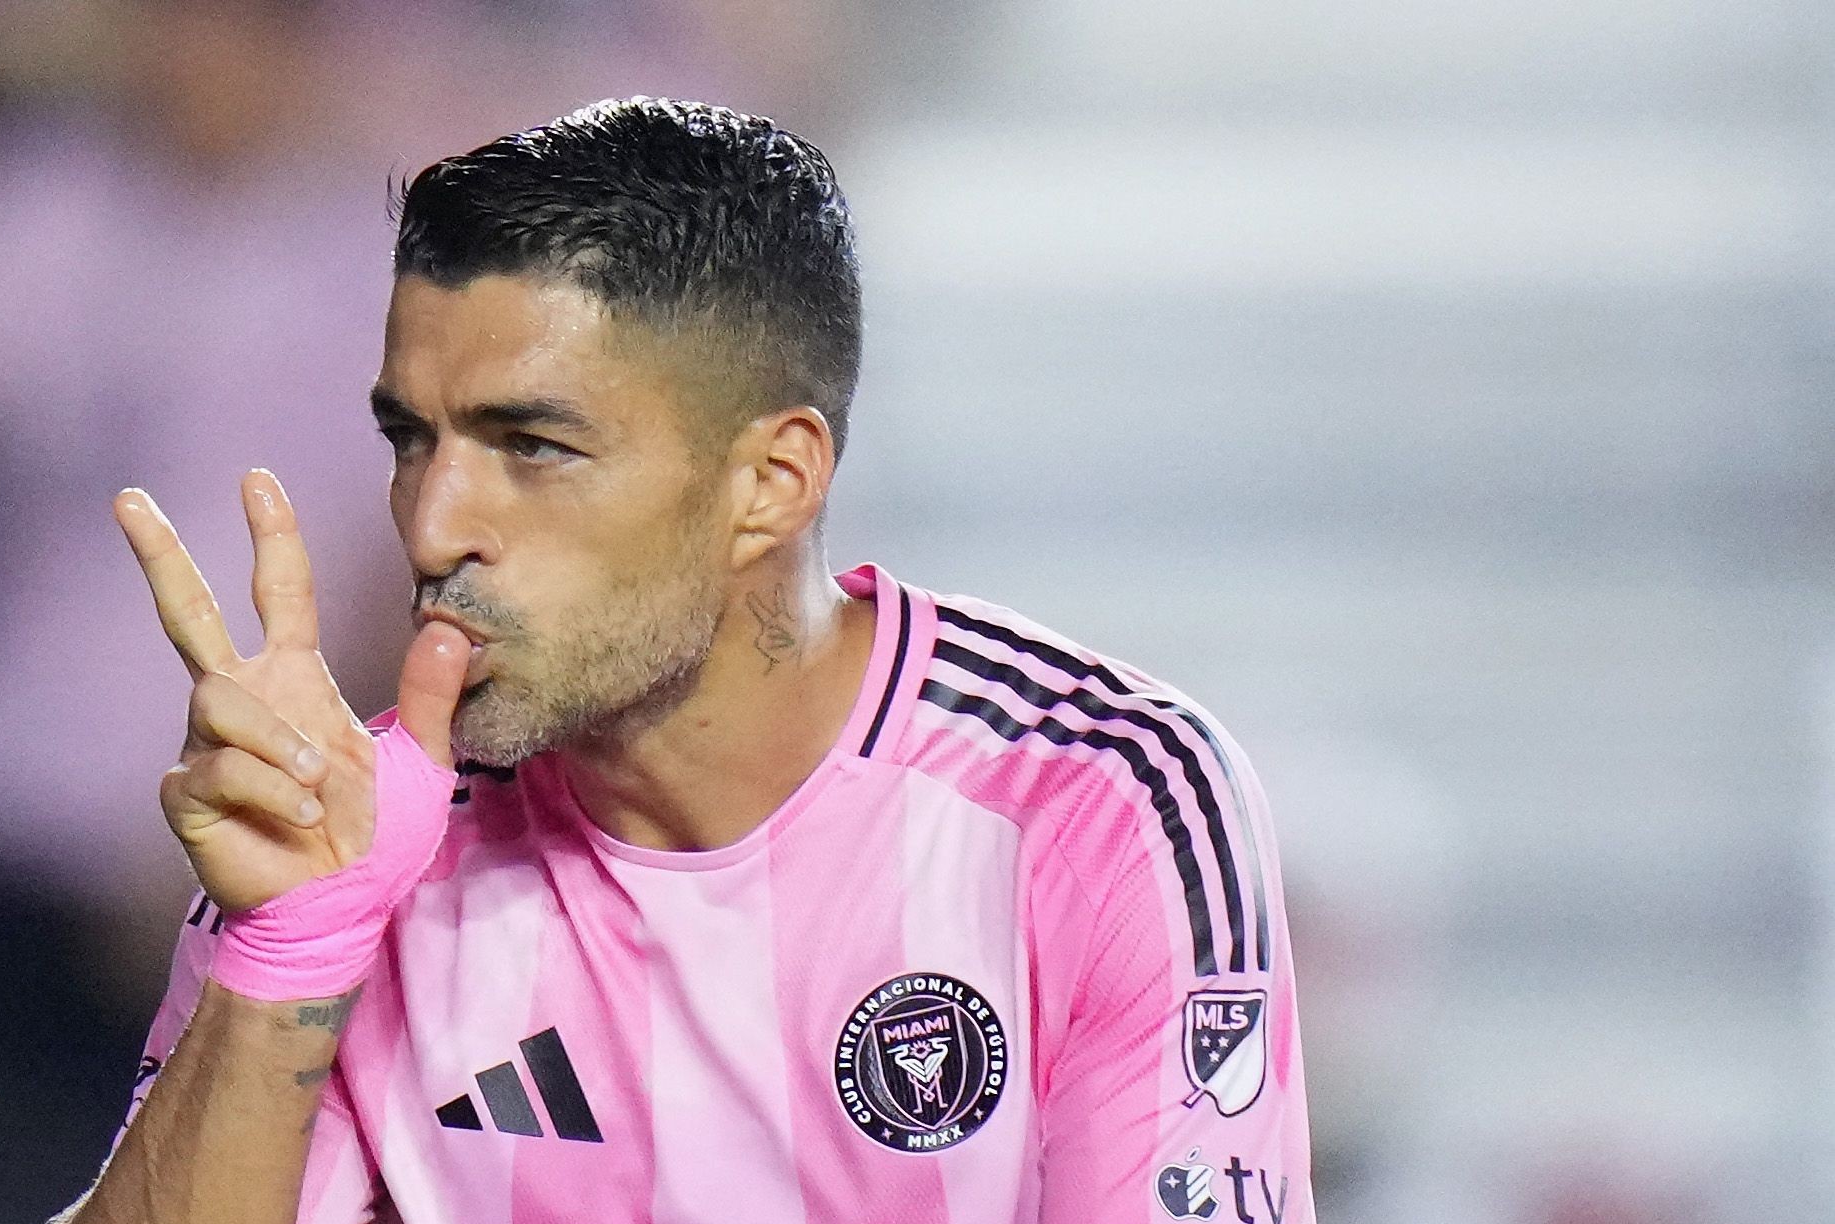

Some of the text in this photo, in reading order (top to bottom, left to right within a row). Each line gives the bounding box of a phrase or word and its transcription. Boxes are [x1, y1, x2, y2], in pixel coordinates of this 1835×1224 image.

[968, 998, 990, 1020] DE
[1195, 1004, 1249, 1030] MLS
[838, 977, 965, 1069] INTERNACIONAL
[882, 1014, 950, 1043] MIAMI
[840, 1077, 871, 1124] CLUB
[906, 1124, 965, 1148] MMXX
